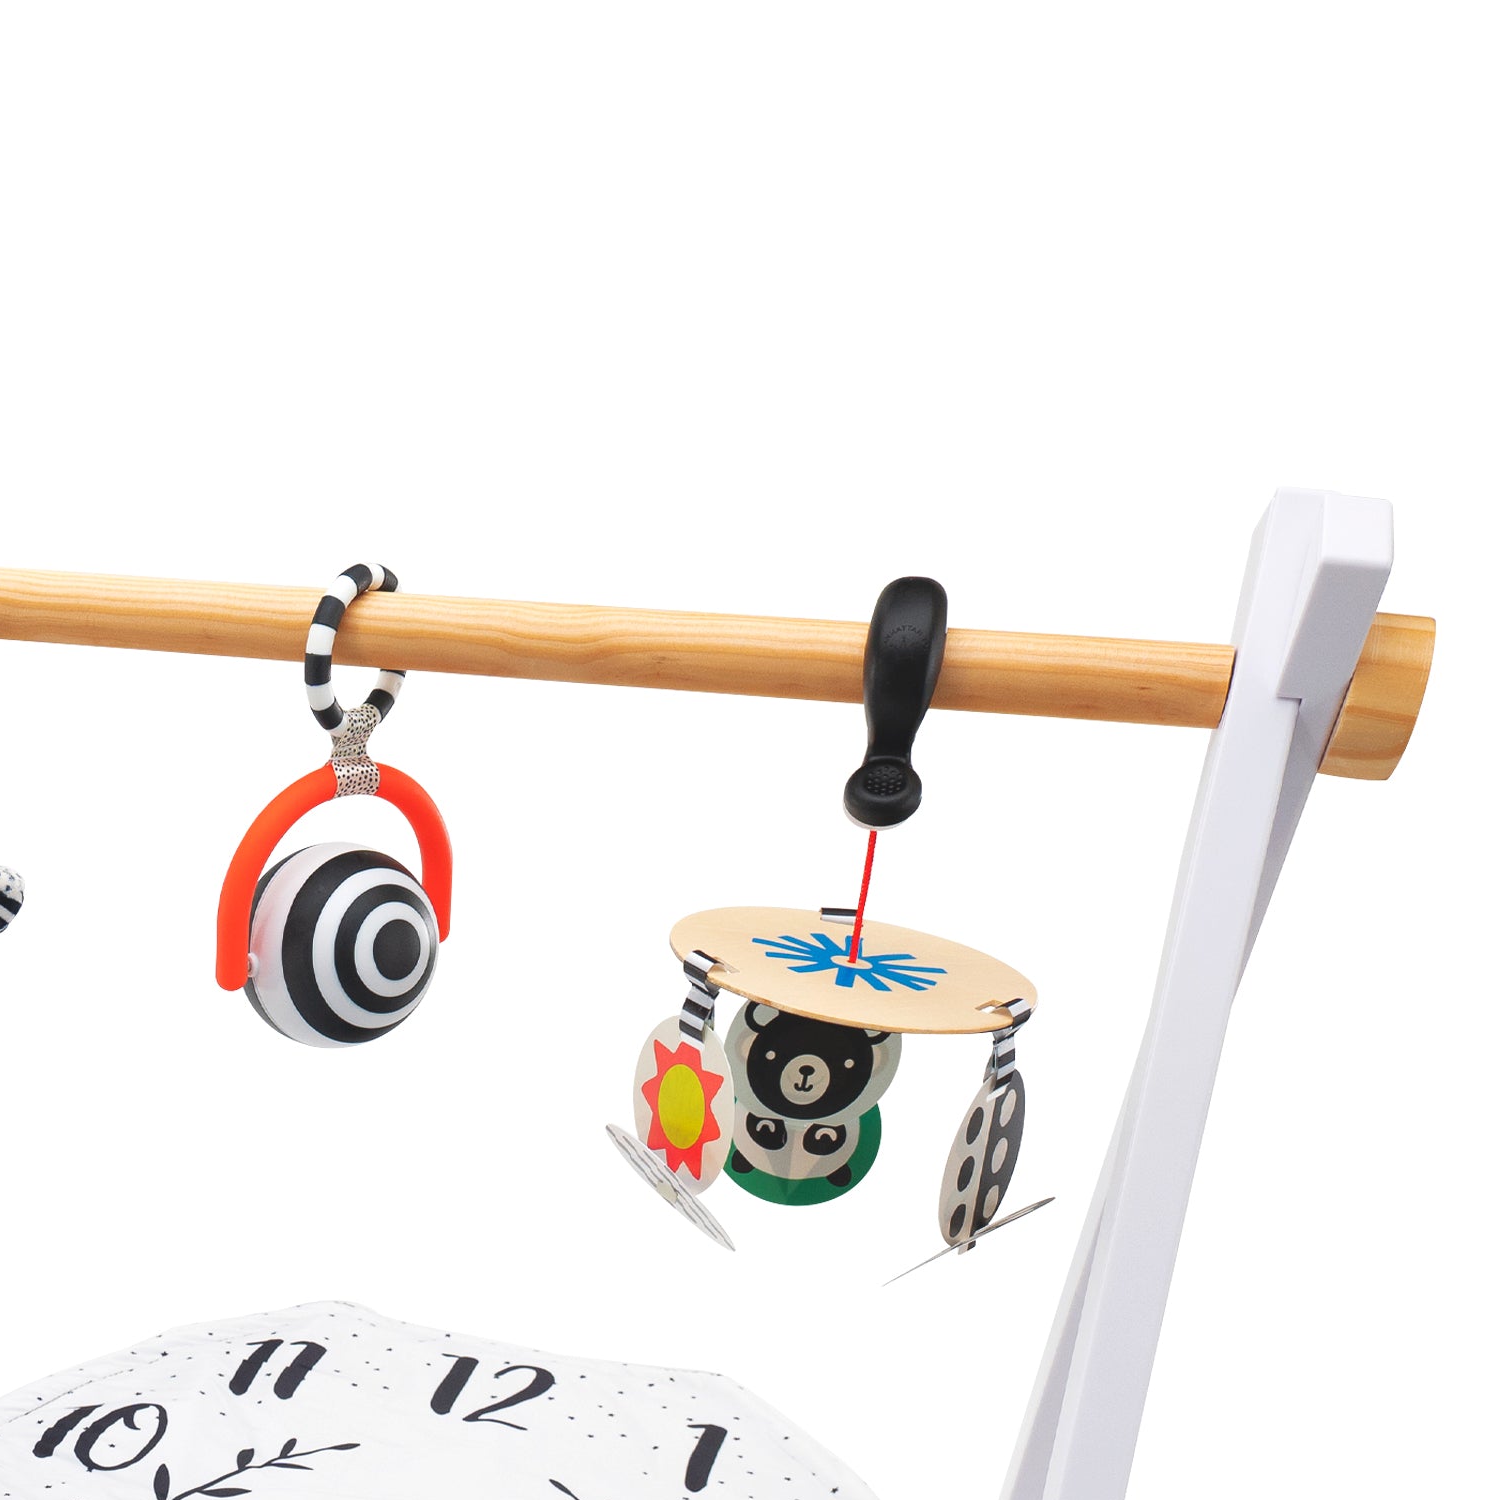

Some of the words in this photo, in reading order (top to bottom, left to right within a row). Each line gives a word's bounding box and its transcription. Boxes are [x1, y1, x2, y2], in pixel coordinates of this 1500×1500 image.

[229, 1339, 327, 1399] 11
[430, 1353, 556, 1431] 12
[33, 1403, 168, 1472] 10
[685, 1424, 728, 1493] 1
